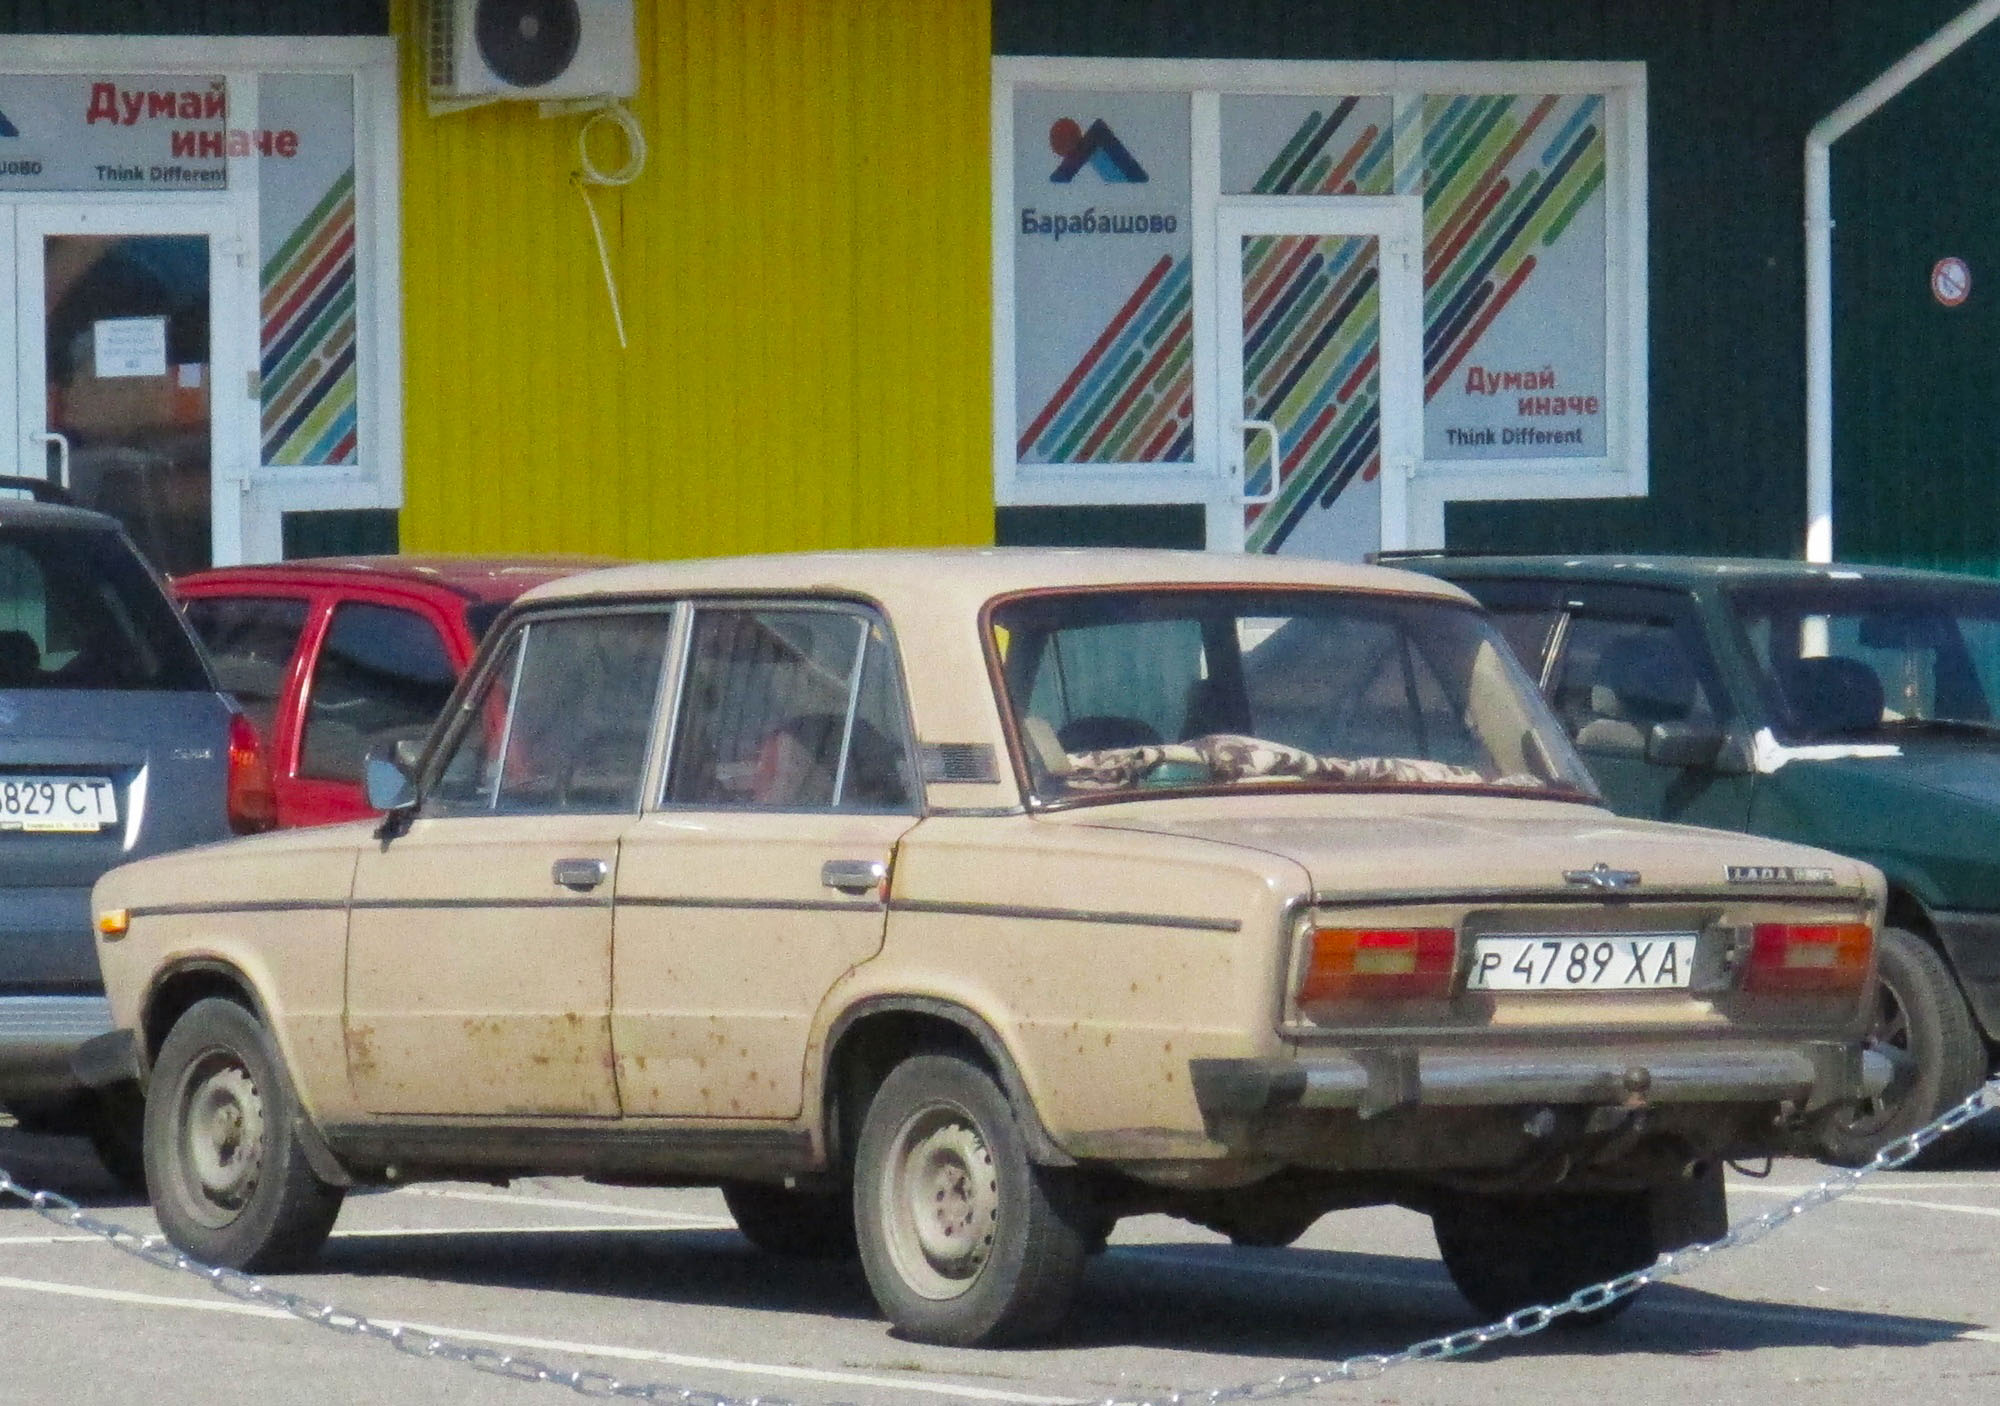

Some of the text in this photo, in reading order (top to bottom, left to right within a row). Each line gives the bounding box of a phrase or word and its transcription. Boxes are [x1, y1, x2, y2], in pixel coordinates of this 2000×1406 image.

[86, 81, 227, 126] Думай
[171, 129, 299, 158] иначе
[95, 165, 227, 183] Think Different
[1021, 206, 1178, 242] Барабашово
[1465, 365, 1555, 395] Думай
[1517, 395, 1599, 416] иначе
[1446, 427, 1583, 446] Think Different
[0, 782, 55, 815] 829
[1513, 942, 1614, 985] 4789
[1624, 942, 1679, 984] ХА
